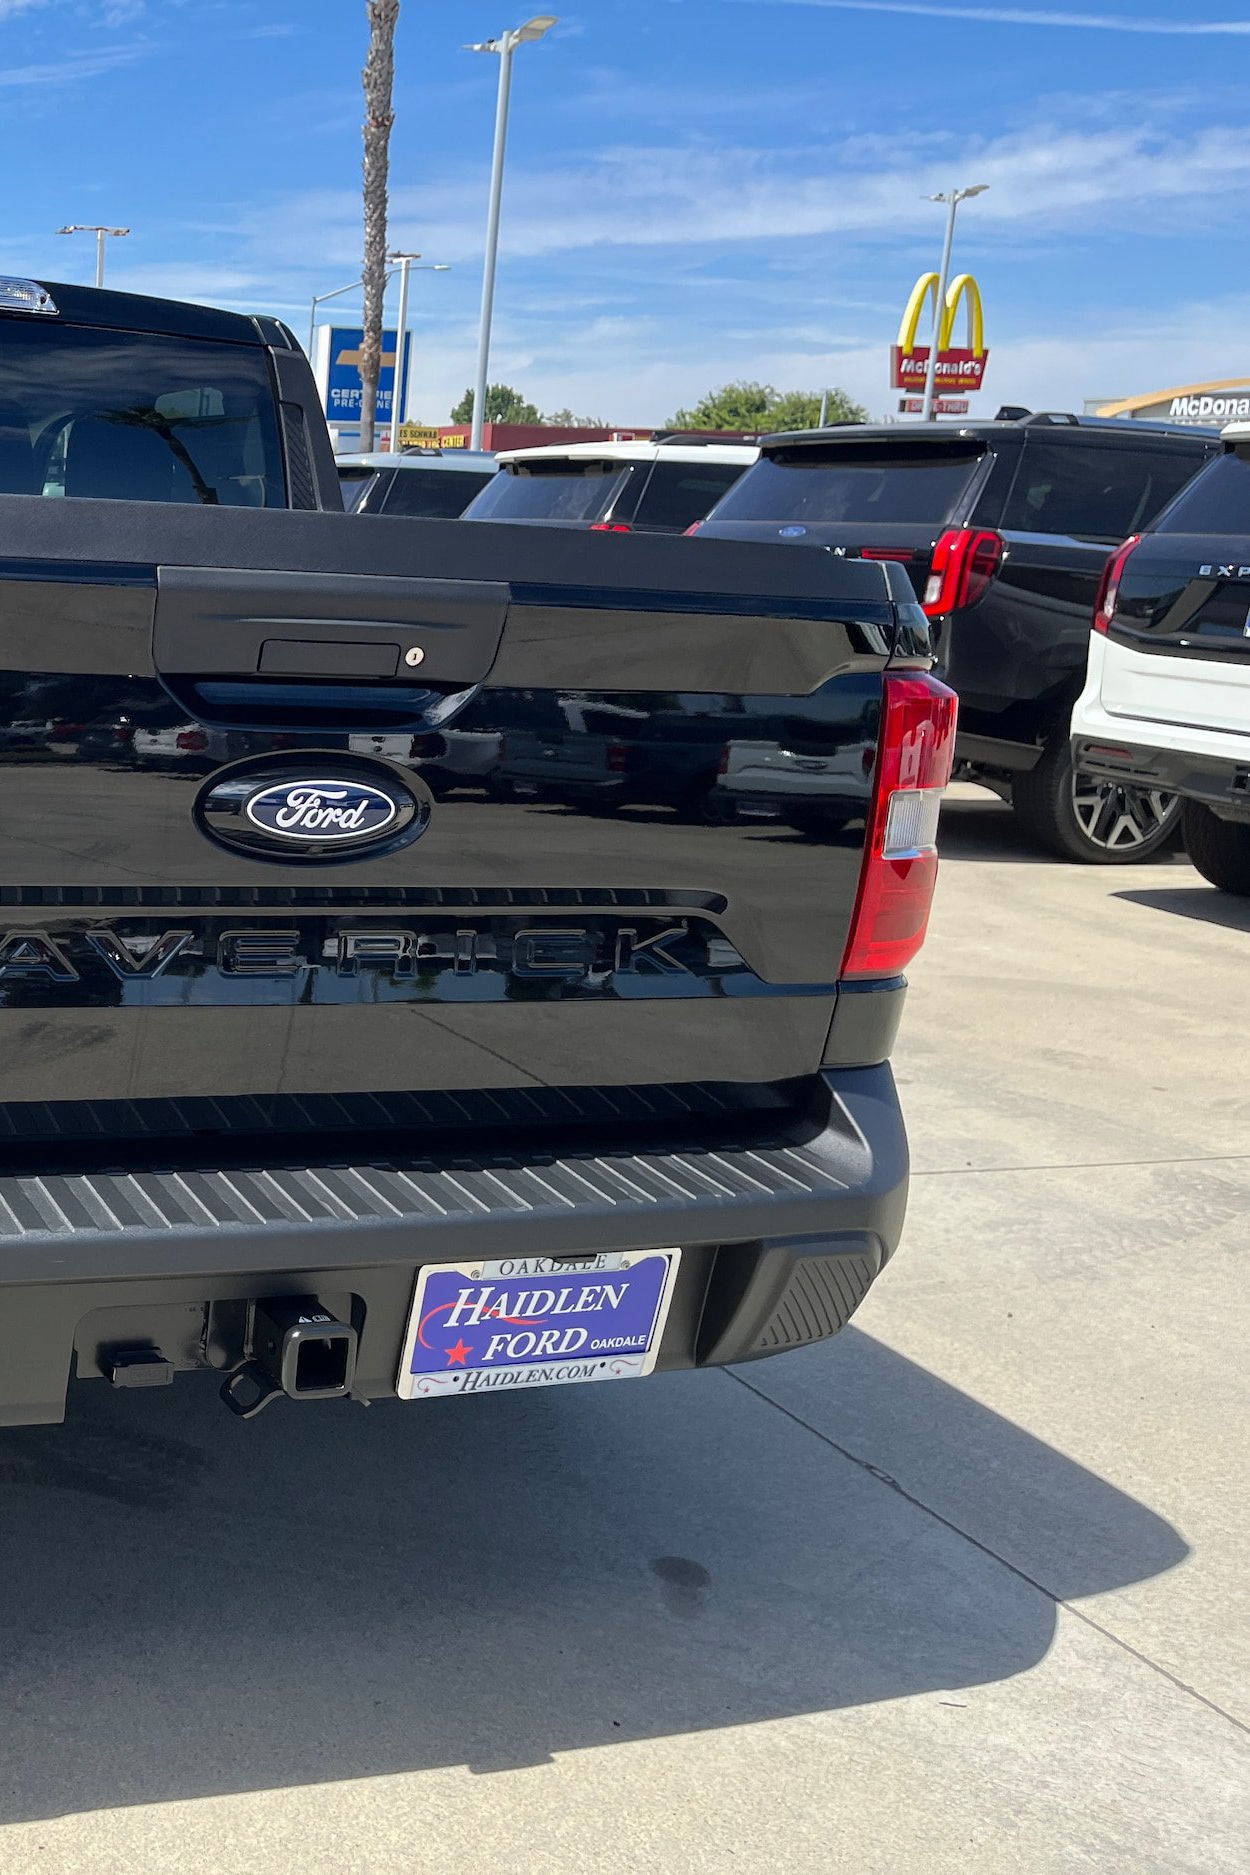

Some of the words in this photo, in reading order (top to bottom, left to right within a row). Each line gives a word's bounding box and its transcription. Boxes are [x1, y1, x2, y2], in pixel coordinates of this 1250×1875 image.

[333, 398, 391, 410] PRE-NE
[1169, 395, 1250, 417] McDona
[275, 788, 370, 830] Ford
[443, 1283, 632, 1328] HAIDLEN
[481, 1327, 589, 1361] FORD
[590, 1334, 647, 1350] OAKDALE
[459, 1363, 598, 1393] HAIDLEN.COM
